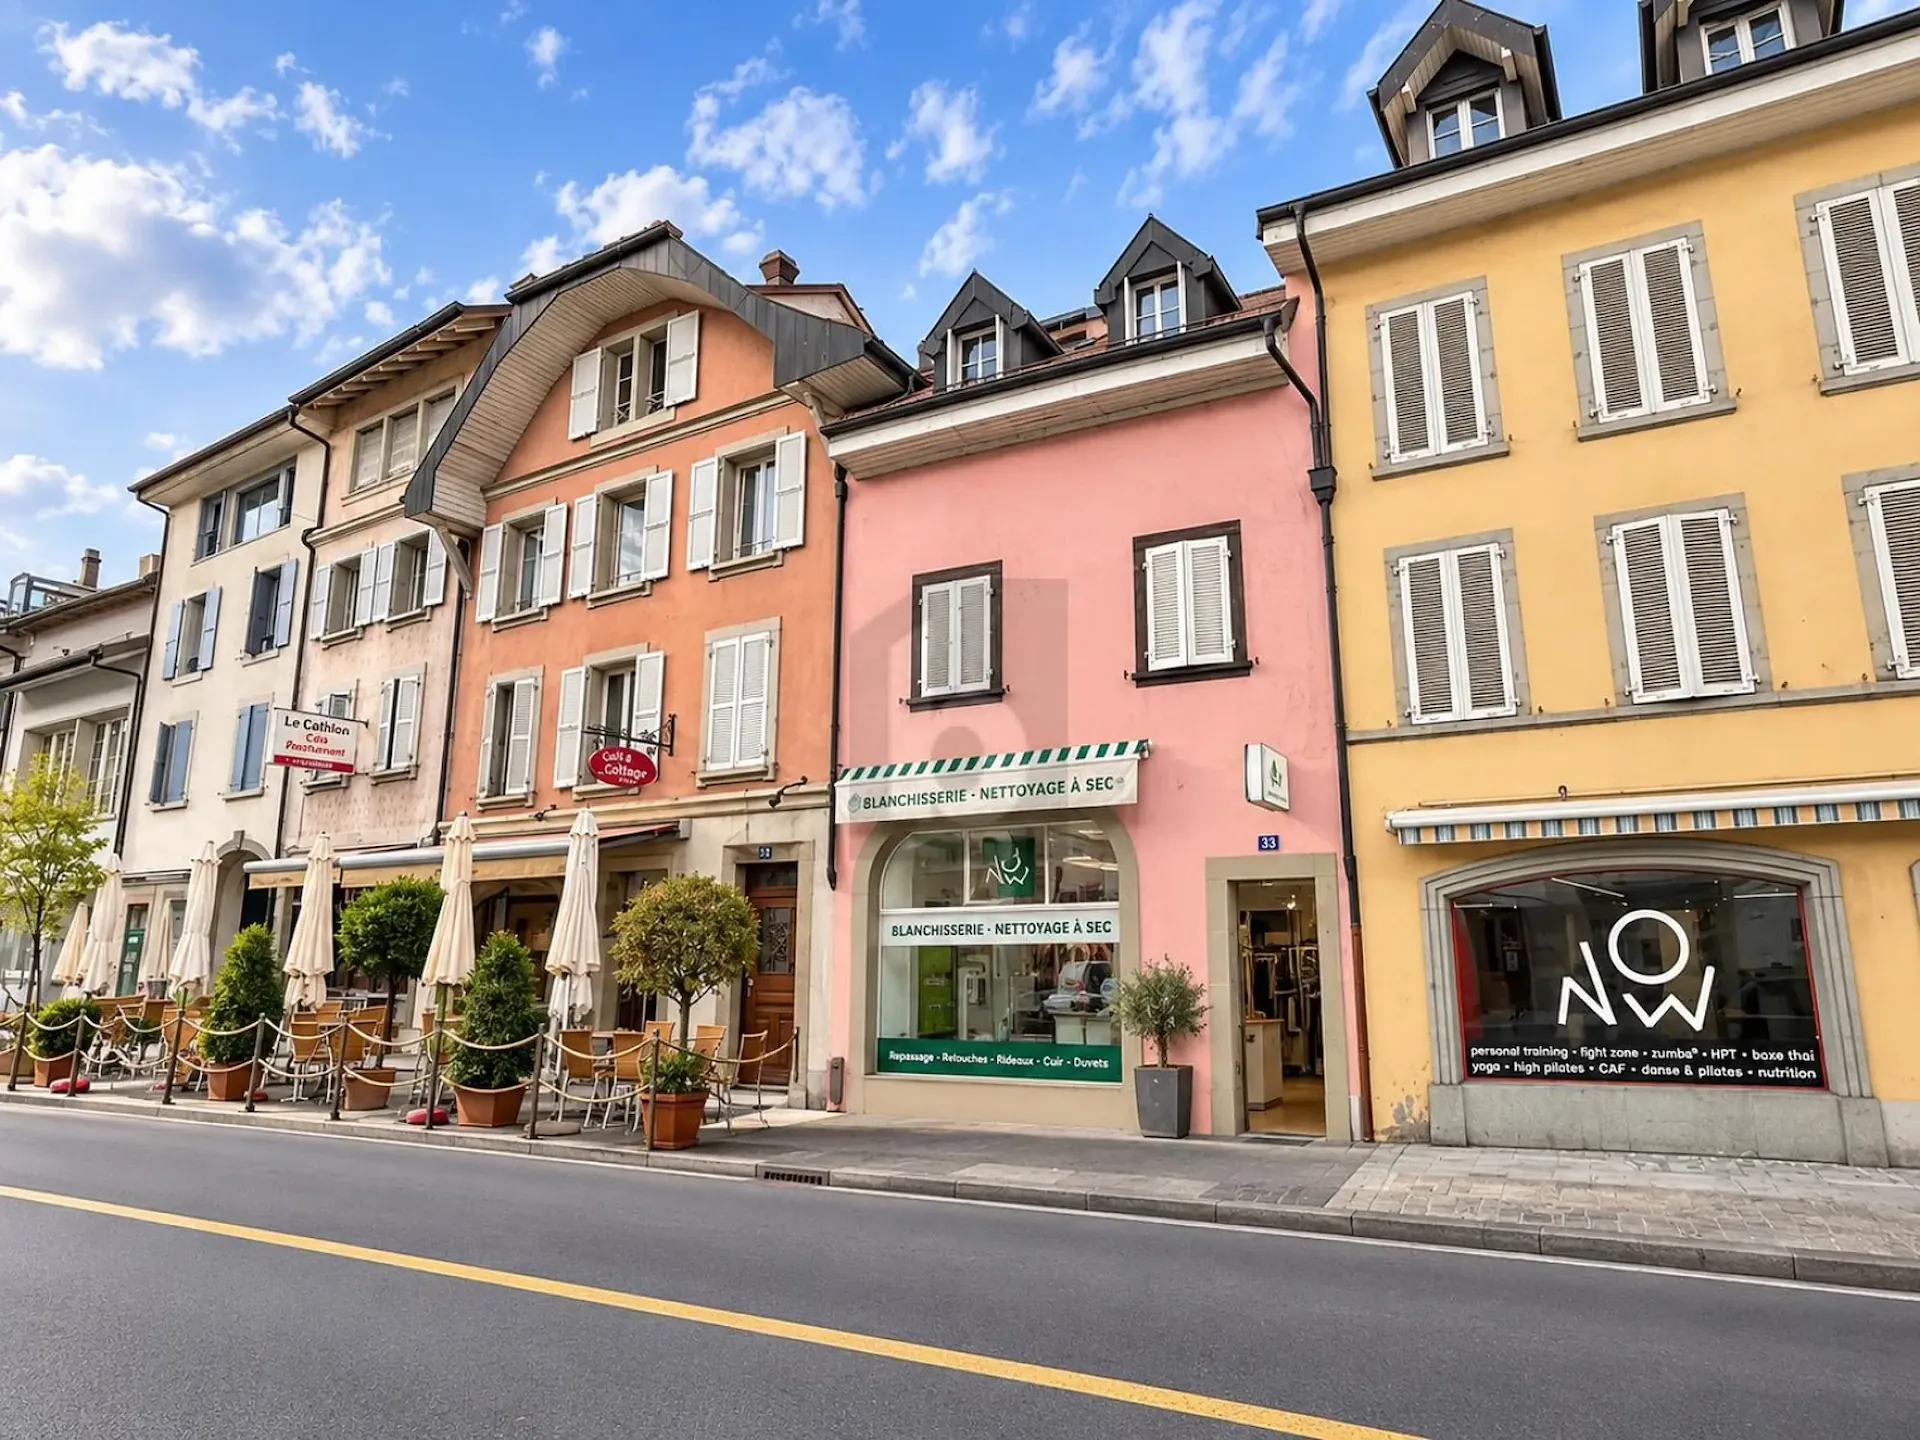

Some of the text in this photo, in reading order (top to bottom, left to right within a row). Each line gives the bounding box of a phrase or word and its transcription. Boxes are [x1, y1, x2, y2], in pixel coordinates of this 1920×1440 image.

[284, 715, 300, 728] Le
[862, 776, 1115, 810] BLANCHISSERIE NETTOYAGE À SEC
[1261, 837, 1276, 849] 33
[891, 918, 1112, 937] BLANCHISSERIE NETTOYAGE À SEC
[1557, 908, 1716, 1032] NOW
[888, 1050, 1109, 1069] Repassage Retouches Rideaux Cuir Duvets
[1470, 1046, 1520, 1058] personal
[1523, 1046, 1569, 1060] training
[1580, 1047, 1607, 1060] fight
[1610, 1050, 1639, 1059] zone
[1711, 1049, 1737, 1060] HPT
[1752, 1049, 1784, 1061] boxe
[1788, 1049, 1815, 1062] thai
[1472, 1061, 1817, 1079] yoga high pilates CAF danse & pilates nutrition
